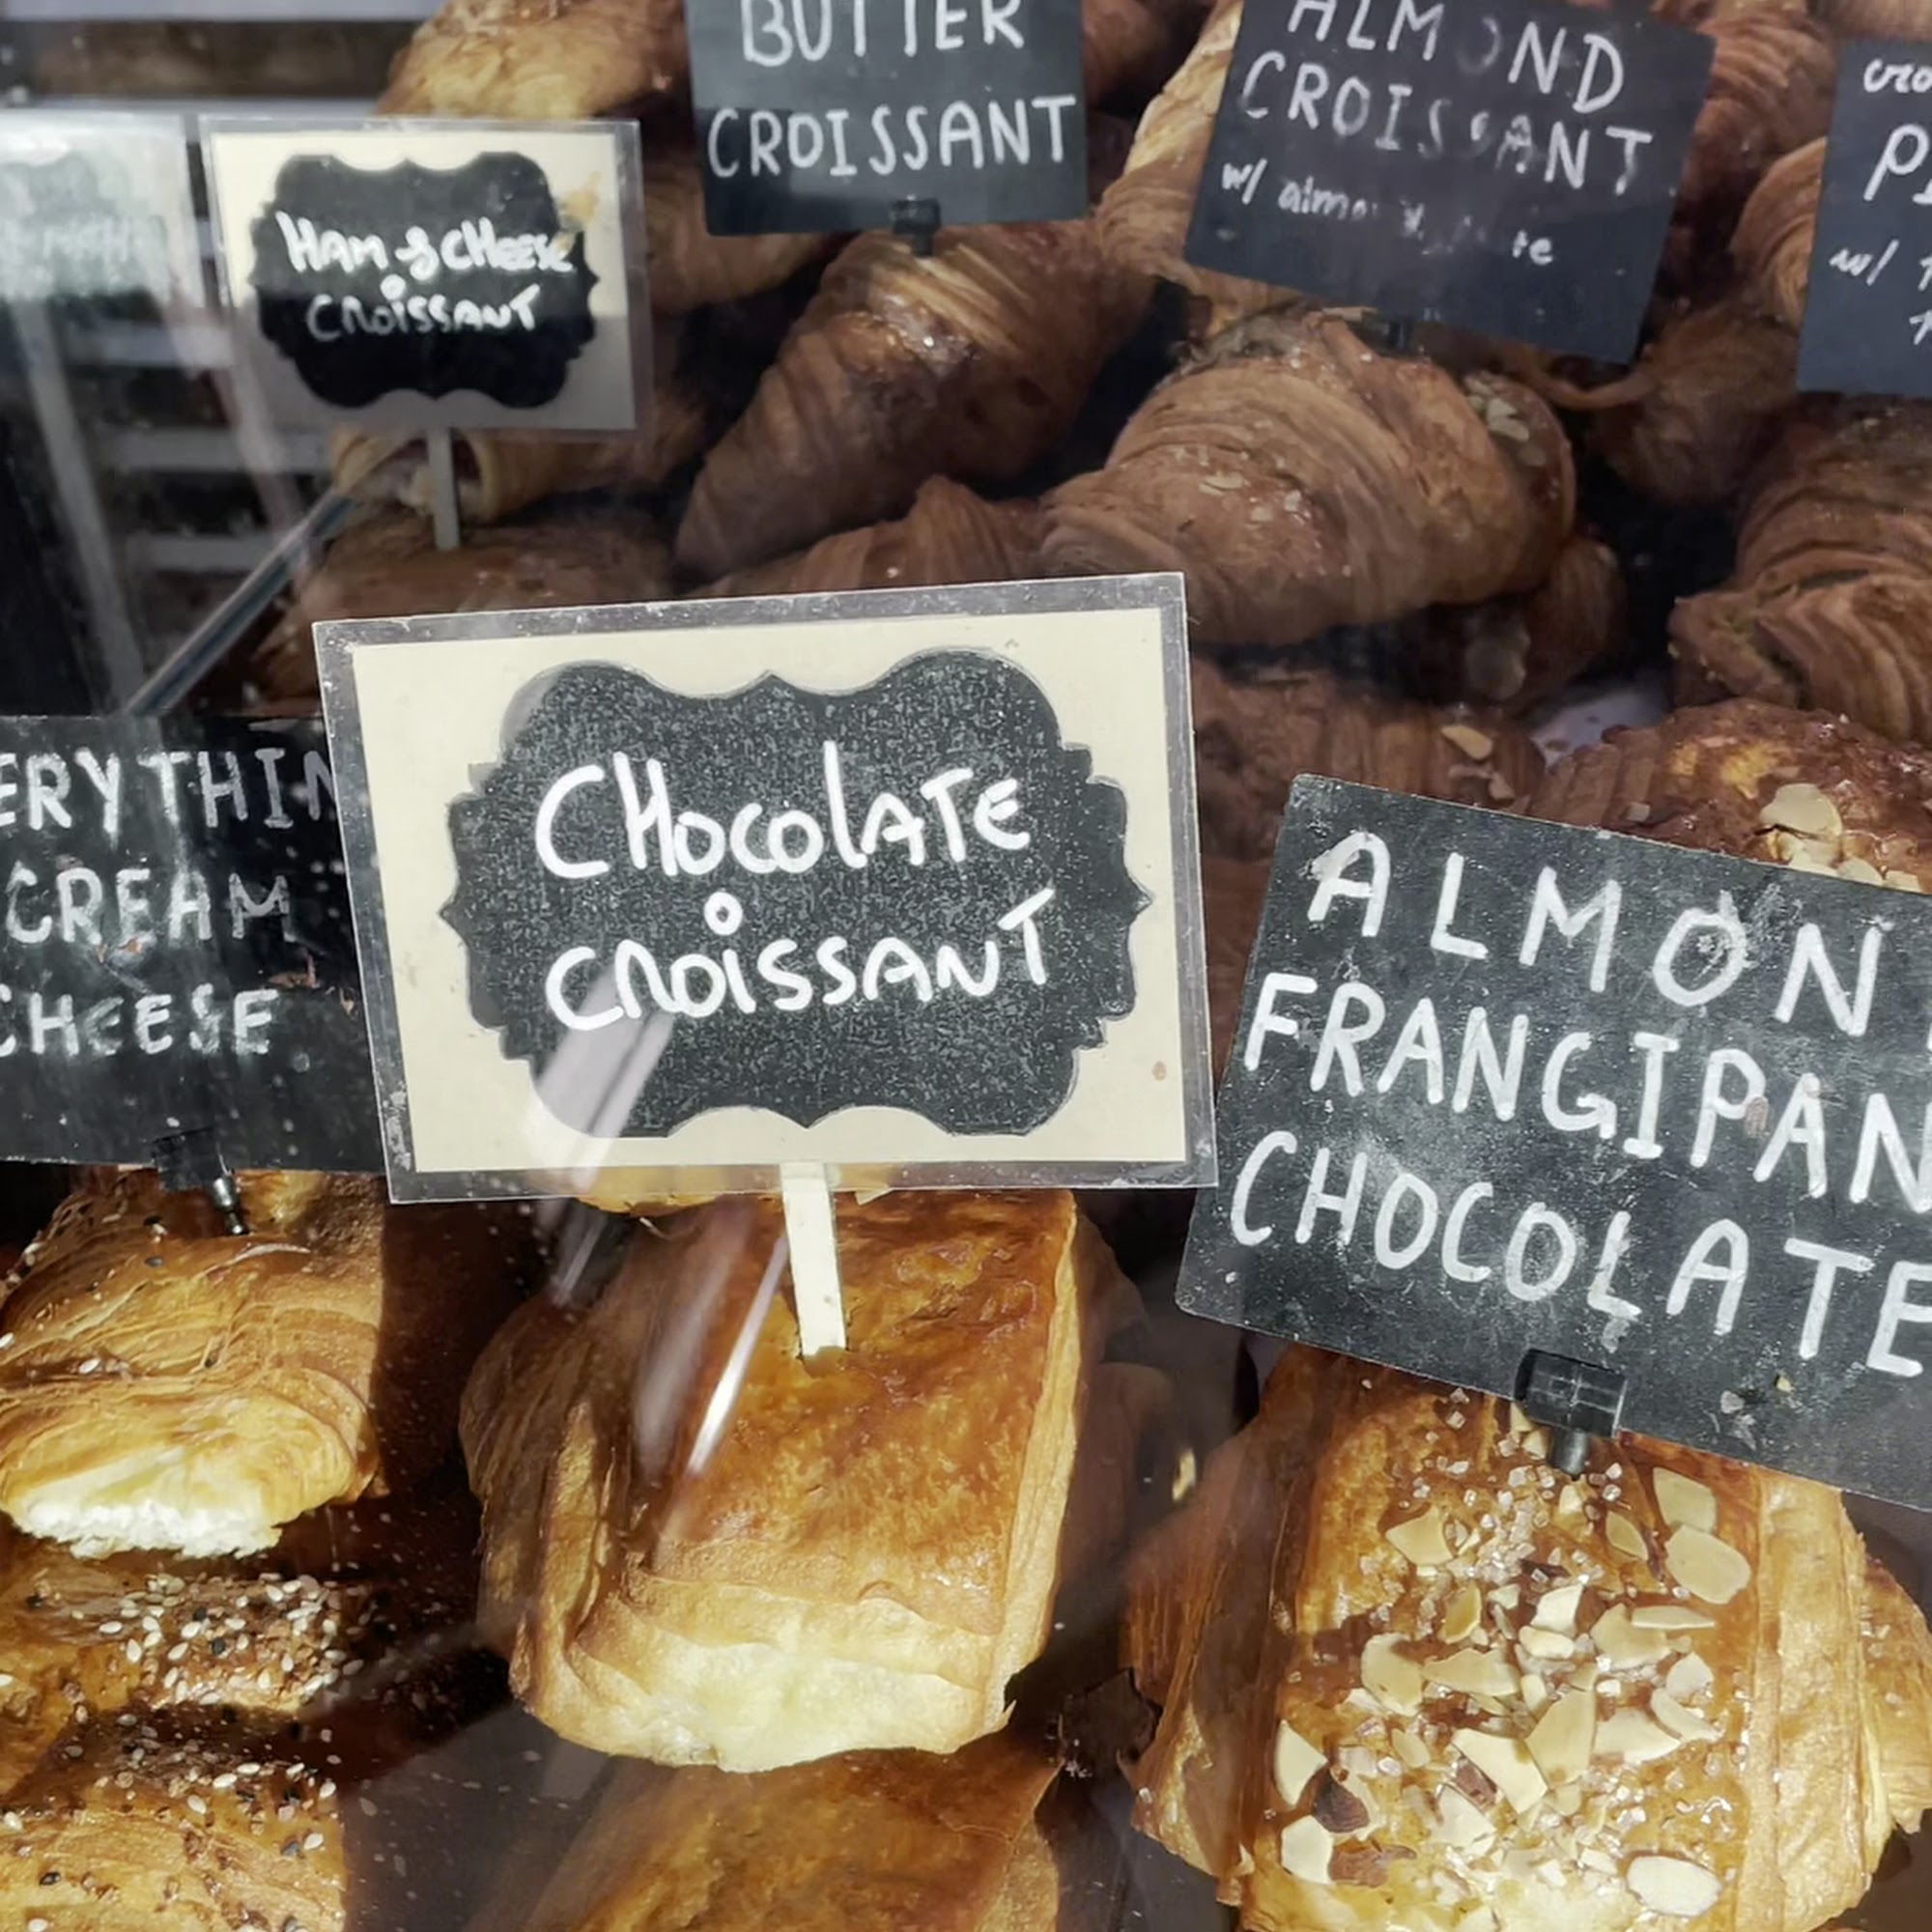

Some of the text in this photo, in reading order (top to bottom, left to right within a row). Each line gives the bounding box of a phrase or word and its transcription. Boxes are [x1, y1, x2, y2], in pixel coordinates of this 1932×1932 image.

[707, 95, 1076, 178] CROISSANT
[1240, 51, 1653, 195] CROISSANT
[6, 863, 295, 945] CREAM
[1307, 832, 1932, 1041] ALMON
[1230, 1130, 1932, 1378] CHOCOLATE
